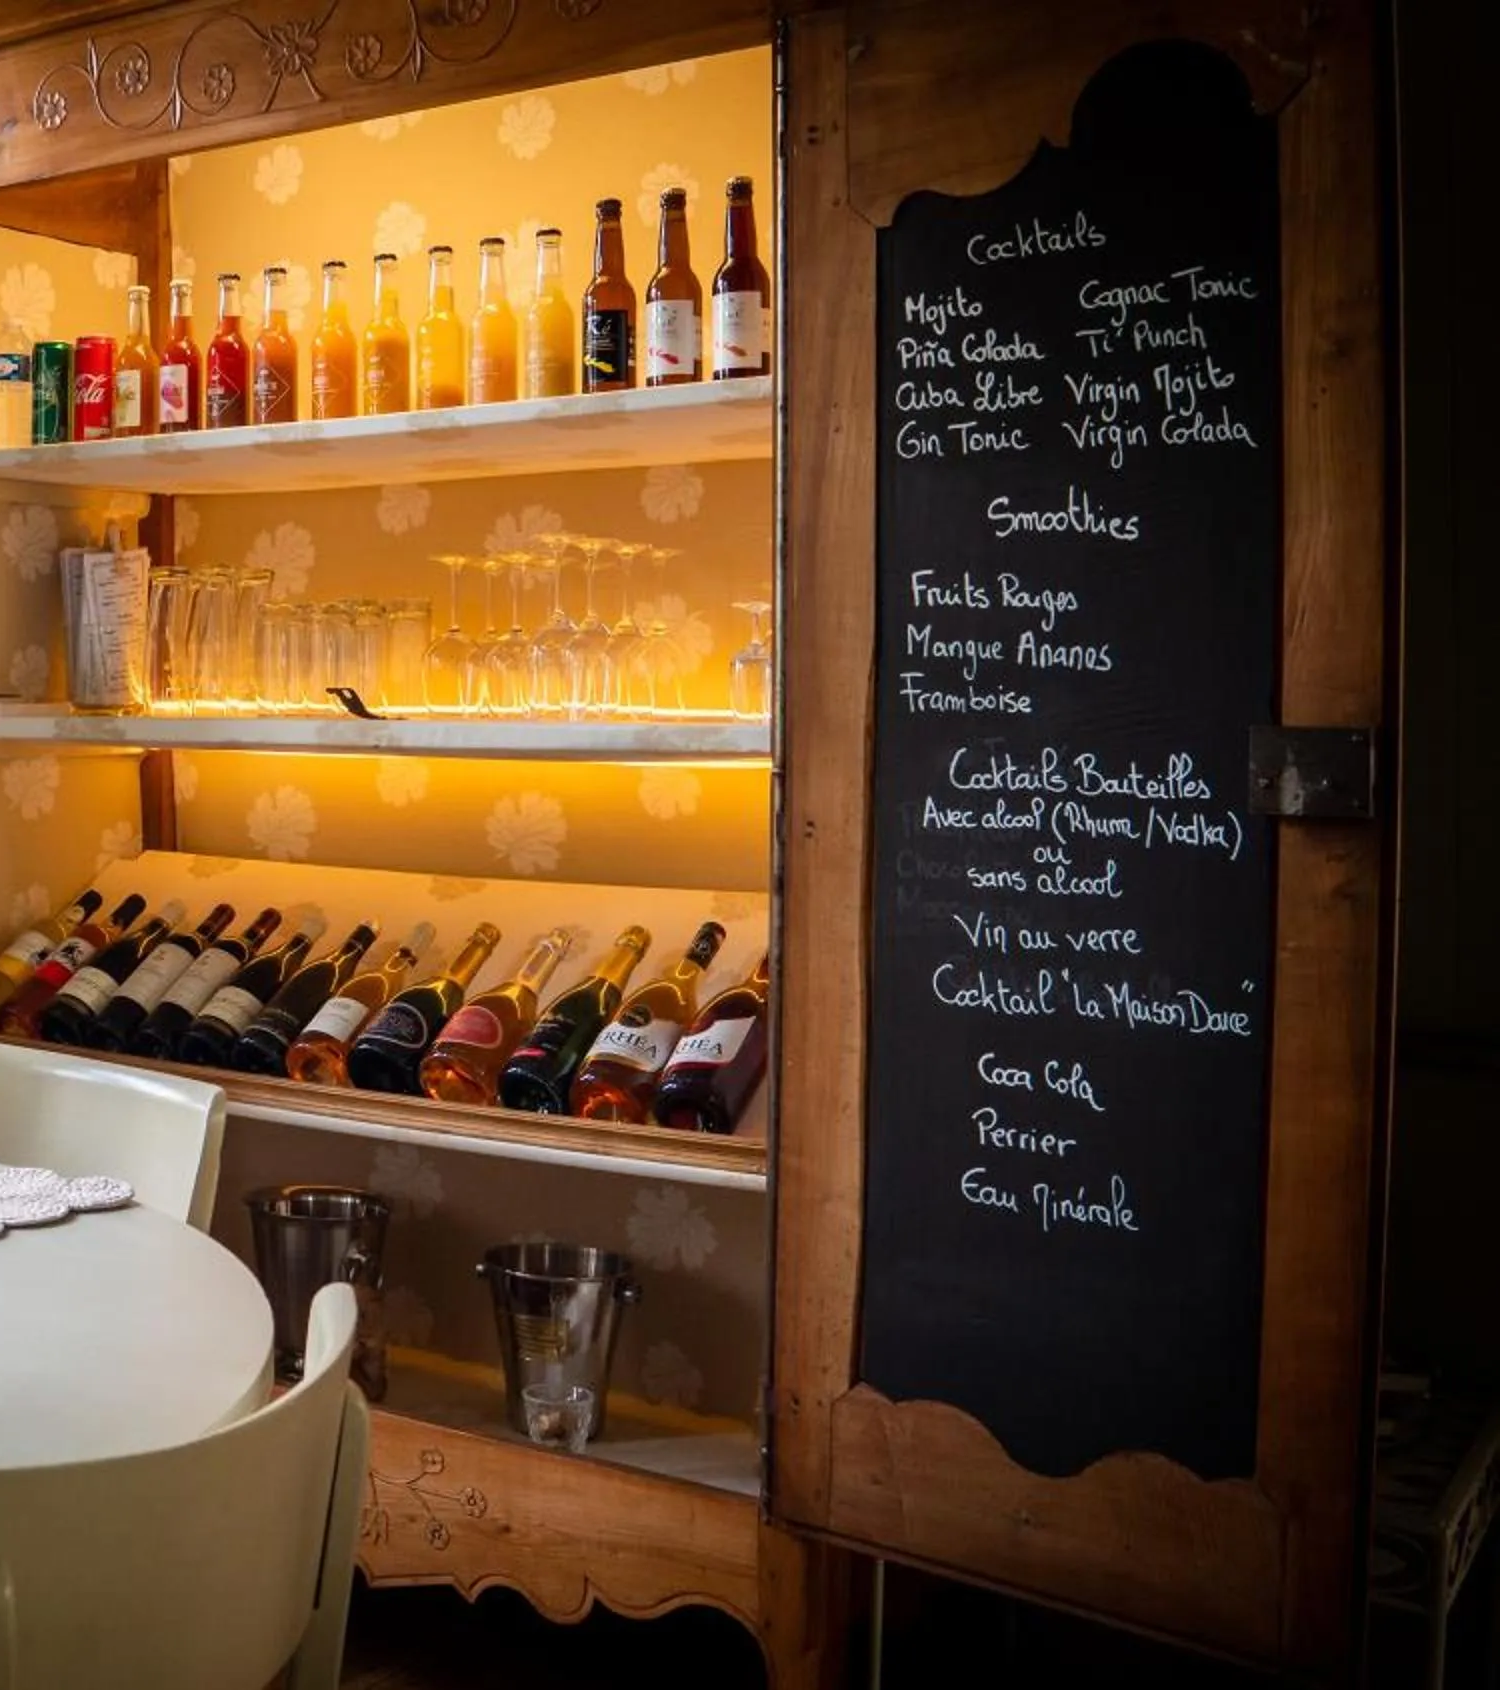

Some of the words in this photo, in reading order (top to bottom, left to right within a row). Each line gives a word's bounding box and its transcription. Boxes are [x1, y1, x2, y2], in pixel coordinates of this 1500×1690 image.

[967, 210, 1107, 266] Cocktails
[904, 287, 983, 335] Mojito
[1079, 279, 1171, 327] Cognac
[1170, 266, 1259, 301] Tonic
[897, 336, 956, 370] Piña
[962, 329, 1046, 363] Colada
[1134, 312, 1208, 351] Punch
[895, 381, 966, 412] Cuba
[973, 371, 1043, 412] Libre
[1064, 372, 1141, 424] Virgin
[1153, 355, 1236, 417] Mojito
[896, 420, 944, 459] Gin
[947, 421, 1031, 456] Tonic
[1061, 414, 1148, 469] Virgin
[1160, 406, 1260, 449] Colada
[986, 484, 1140, 541] Smoothies
[911, 569, 990, 609] Fruits
[998, 572, 1079, 632] Rouges
[906, 623, 1004, 680] Mangue
[1017, 630, 1112, 672] Ananas
[899, 671, 1033, 714] Framboise
[948, 747, 1068, 794] Cocktails
[1074, 752, 1211, 800] Bouteilles
[923, 795, 977, 830] Avec
[982, 797, 1045, 830] alcool
[1033, 843, 1072, 865] ou
[967, 866, 1027, 892] sans
[1037, 859, 1124, 899] alcool
[953, 911, 1007, 954] Vin
[1019, 928, 1058, 951] au
[1066, 926, 1142, 954] verre
[932, 963, 1056, 1015] Cocktail
[1104, 981, 1186, 1030] Maison
[978, 1052, 1033, 1091] Coca
[1044, 1060, 1106, 1111] Cola
[971, 1107, 1077, 1157] Perrier
[961, 1167, 1020, 1213] Eau
